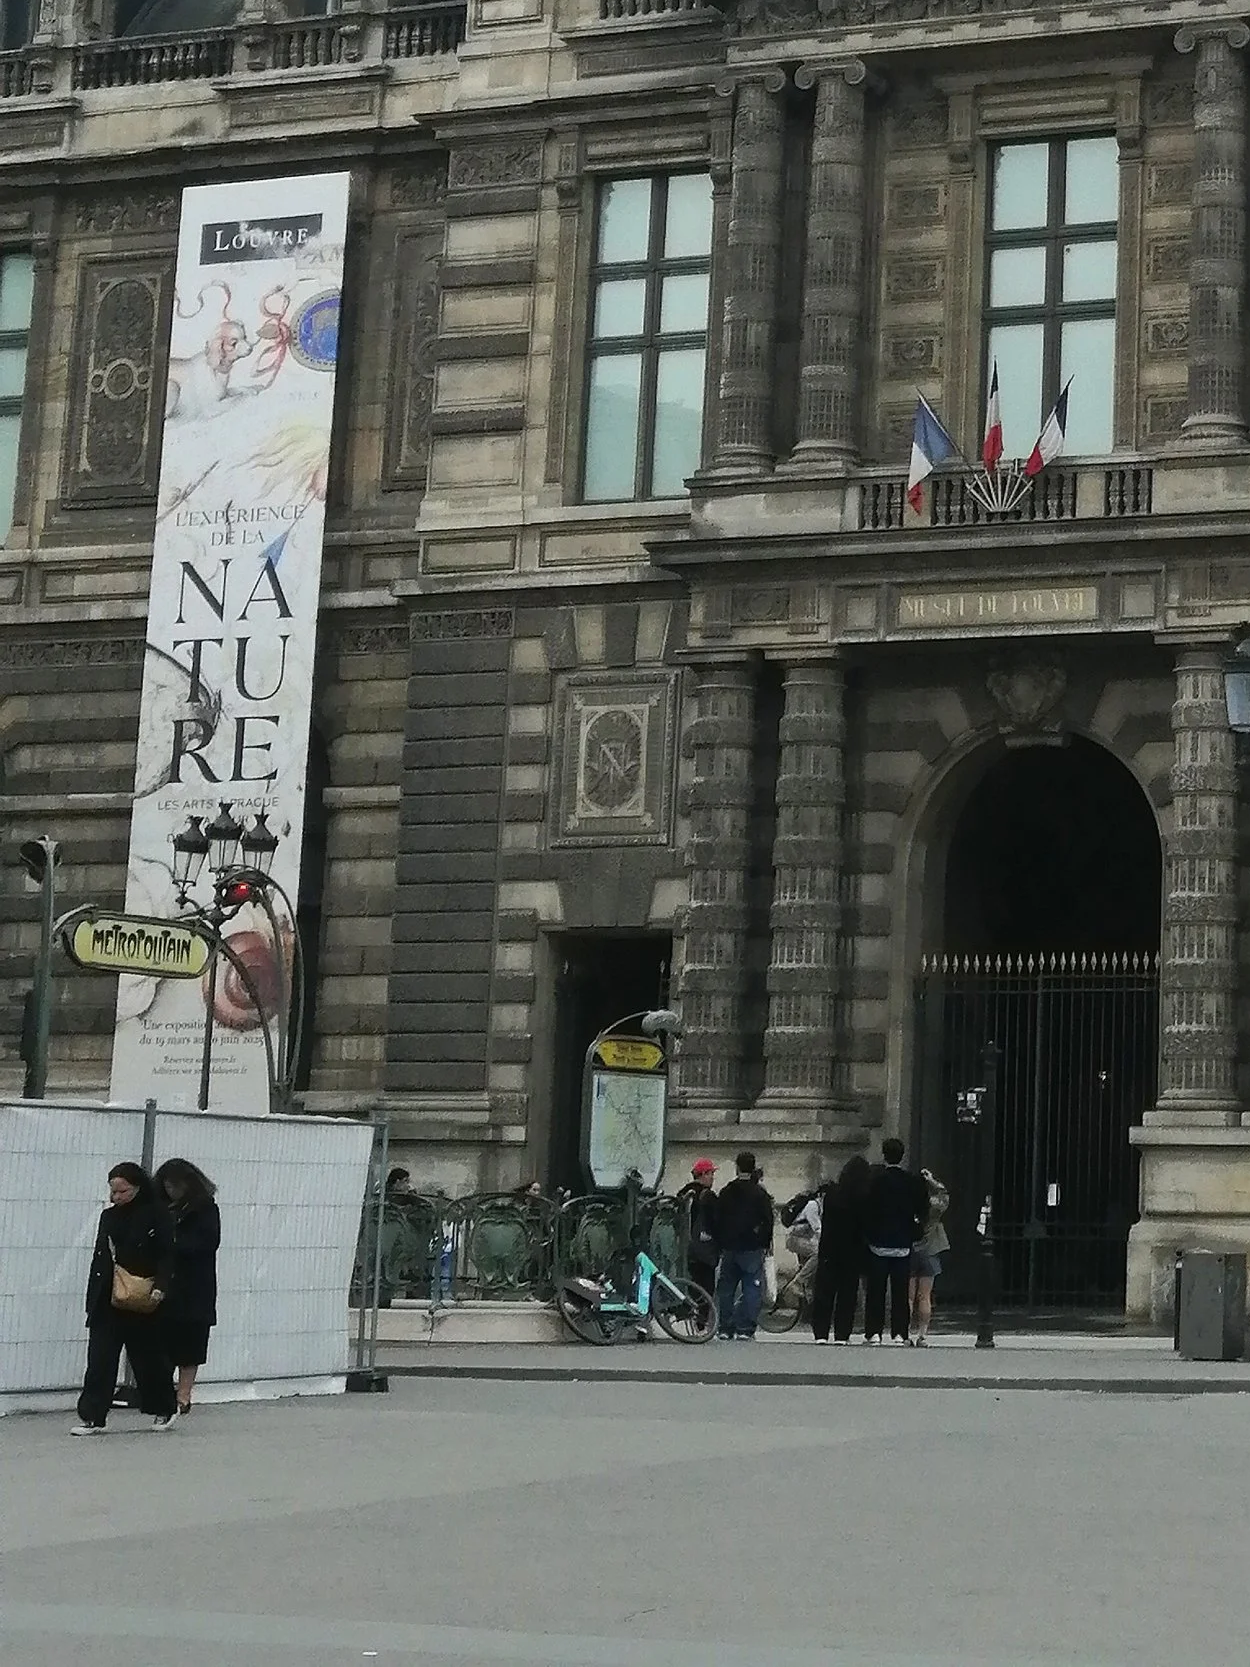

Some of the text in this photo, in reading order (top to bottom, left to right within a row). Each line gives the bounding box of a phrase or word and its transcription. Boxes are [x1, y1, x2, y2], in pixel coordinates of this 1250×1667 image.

[213, 228, 309, 252] LOUVRE
[211, 529, 265, 546] DE LA
[174, 555, 294, 624] NA
[172, 635, 291, 703] TU
[167, 715, 280, 783] RE
[158, 800, 179, 811] LES
[182, 799, 214, 810] ARTS
[231, 796, 281, 808] PRAGUE
[92, 924, 193, 966] METROPOLITAIN
[139, 1033, 152, 1045] du
[167, 1036, 190, 1045] mars
[220, 1036, 239, 1046] juin
